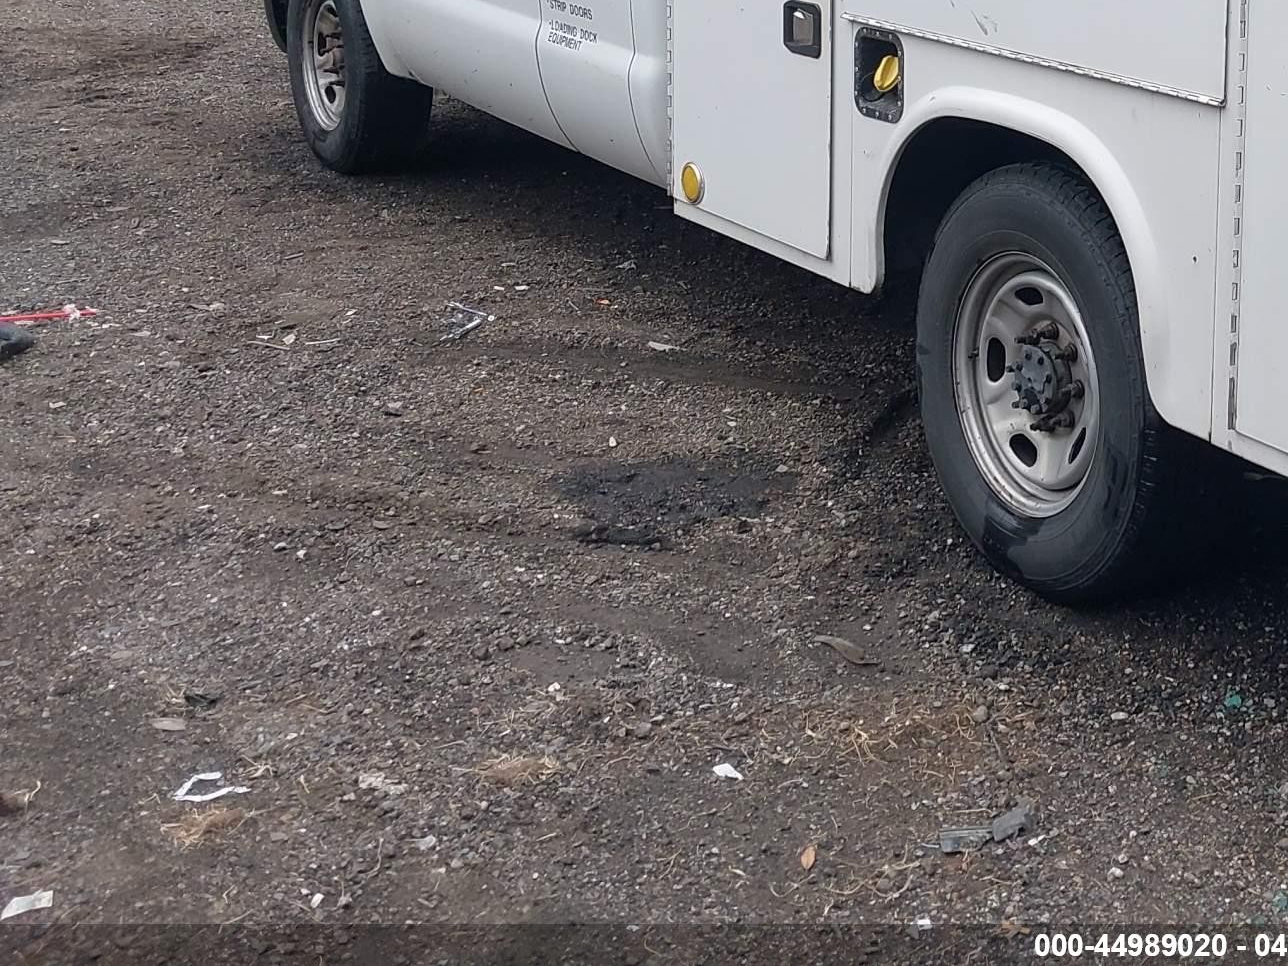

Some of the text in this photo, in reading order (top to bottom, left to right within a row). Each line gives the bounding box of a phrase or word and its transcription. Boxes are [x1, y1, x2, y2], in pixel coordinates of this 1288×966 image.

[569, 3, 593, 20] DOORS
[550, 19, 598, 43] LOADING DOCK
[547, 32, 583, 51] EQUIPMENT
